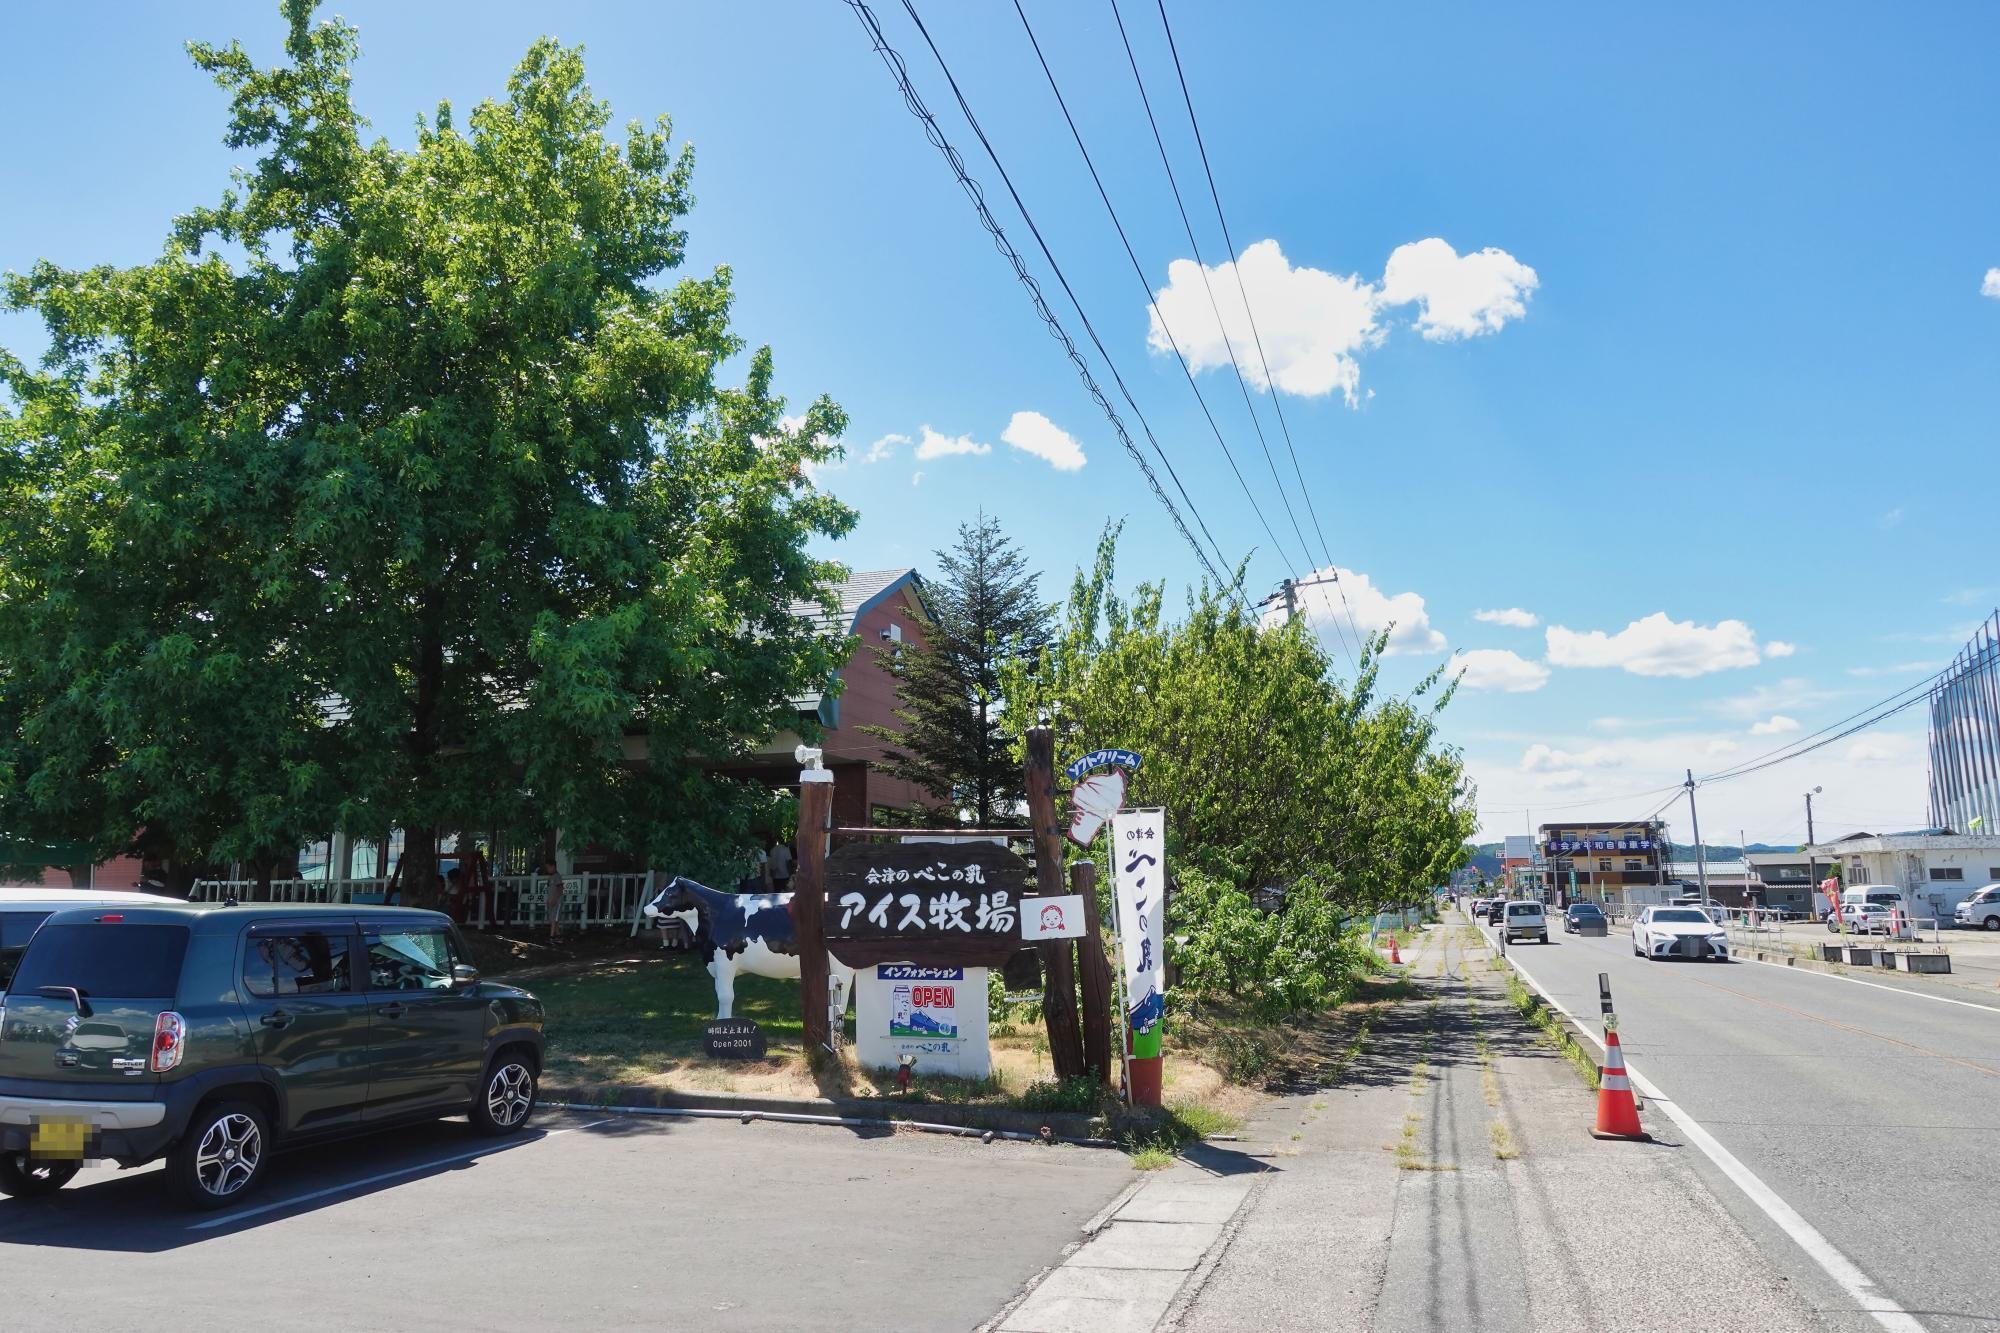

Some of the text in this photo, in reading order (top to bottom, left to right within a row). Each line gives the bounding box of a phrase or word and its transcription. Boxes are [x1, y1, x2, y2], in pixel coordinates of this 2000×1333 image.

[1068, 751, 1136, 776] ソフトクリーム
[839, 890, 1018, 933] アイス牧場
[884, 966, 958, 979] インフォメーション
[912, 985, 955, 1009] OPEN
[713, 1040, 752, 1049] Open 2001
